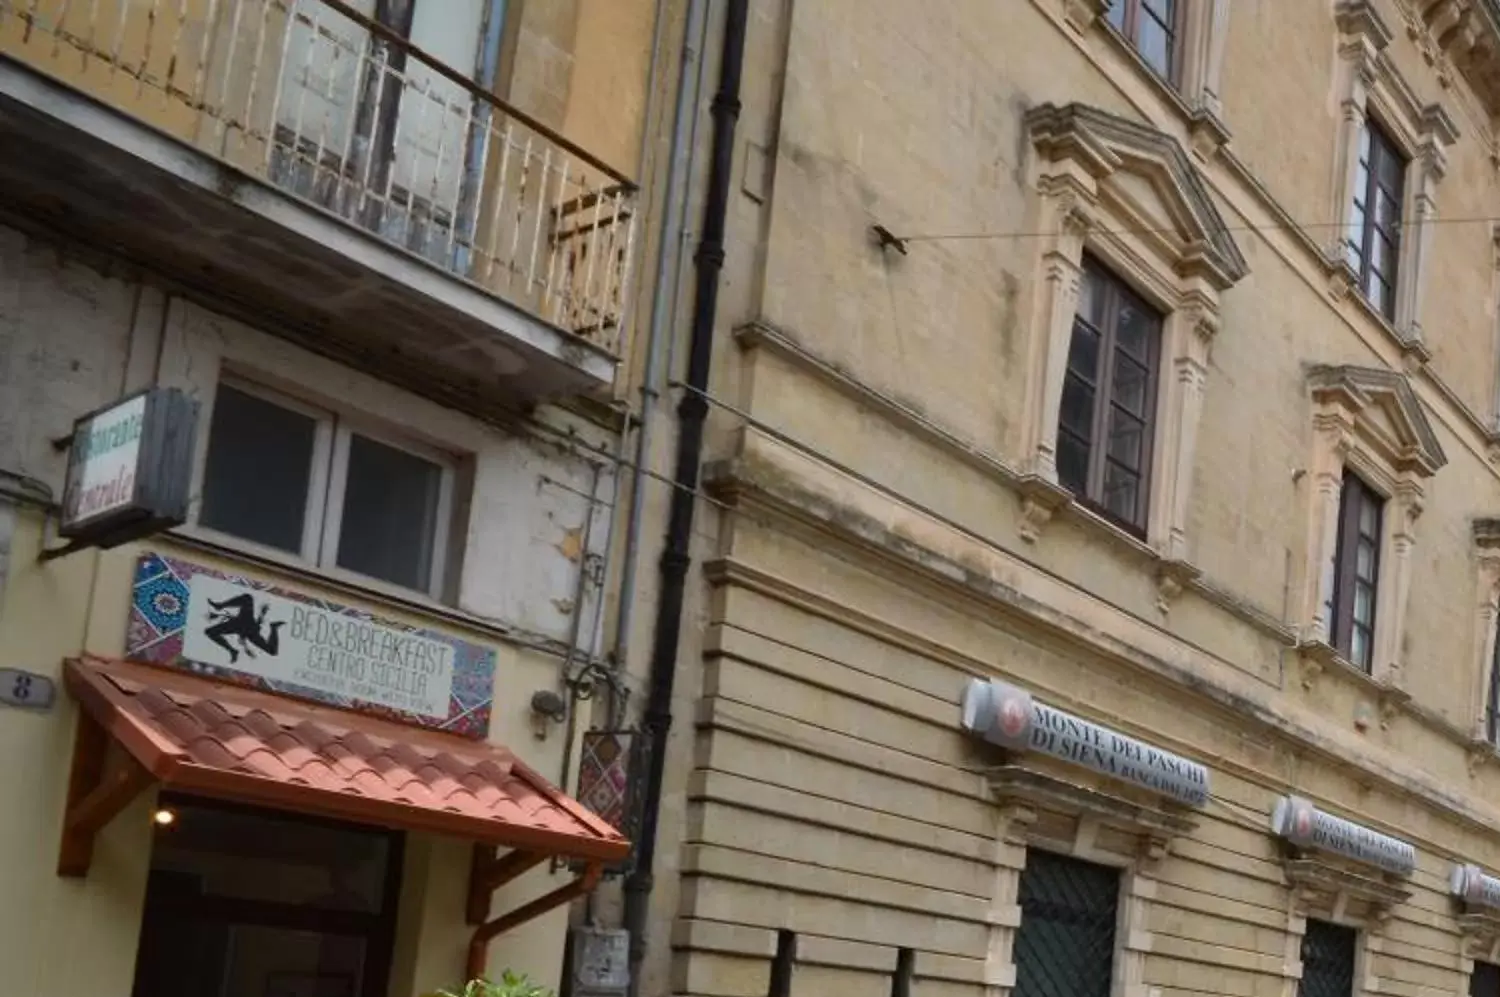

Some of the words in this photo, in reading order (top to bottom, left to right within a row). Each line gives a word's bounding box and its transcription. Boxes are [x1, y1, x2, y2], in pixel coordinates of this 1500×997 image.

[290, 606, 450, 676] BED&BREAKFAST
[306, 644, 366, 682] CENTRO
[371, 660, 428, 696] SICILIA
[12, 674, 33, 699] 8
[1032, 727, 1056, 751] DI
[1058, 736, 1116, 773] SIENA
[1033, 706, 1106, 749] MONTE
[1111, 735, 1141, 762] DEI
[1147, 749, 1205, 785] PASCHI
